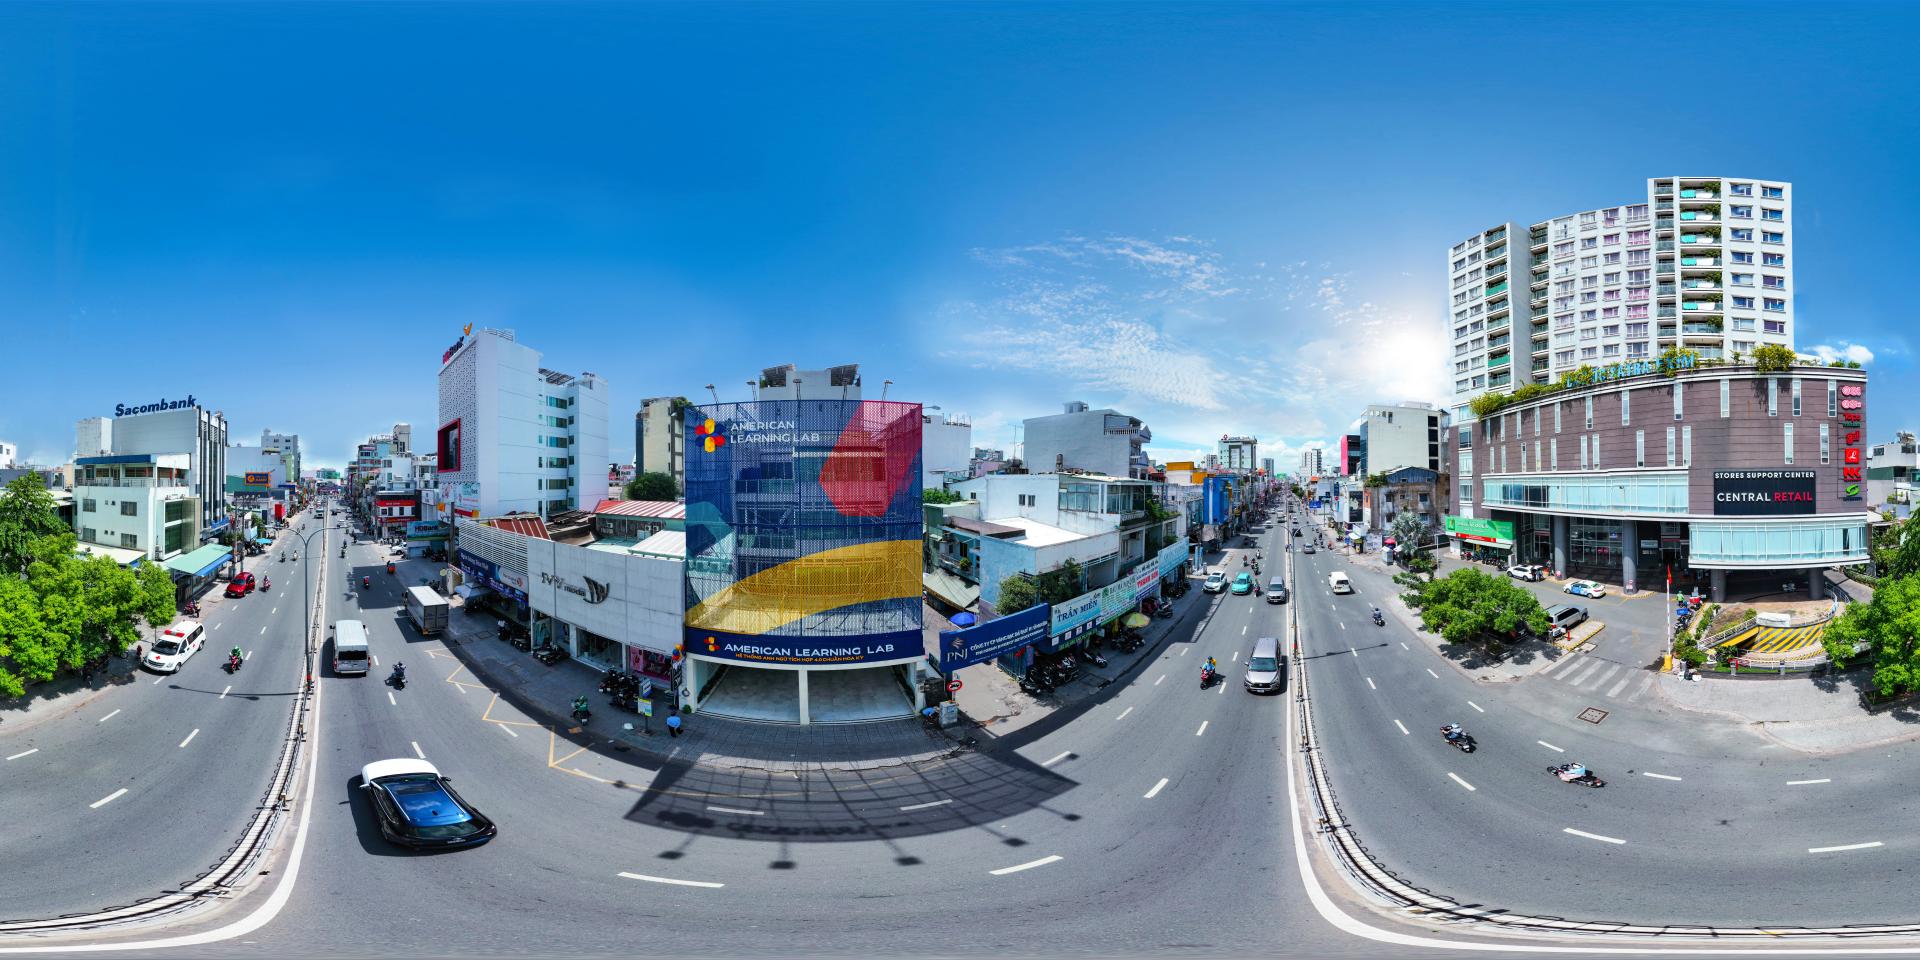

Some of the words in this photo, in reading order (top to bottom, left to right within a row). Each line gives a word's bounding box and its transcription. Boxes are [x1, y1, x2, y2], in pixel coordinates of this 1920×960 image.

[1610, 361, 1650, 379] SATRA
[115, 395, 196, 417] Sacombank
[731, 421, 795, 431] AMERICAN
[731, 433, 790, 443] LEARNING
[793, 433, 820, 442] LAB
[1716, 492, 1771, 502] CENTRAL
[1774, 491, 1813, 502] RETAIL
[564, 585, 586, 597] moda
[724, 643, 791, 656] AMERICAN
[795, 647, 861, 657] LEARNING
[867, 644, 894, 654] LAB
[947, 649, 968, 662] PNJ
